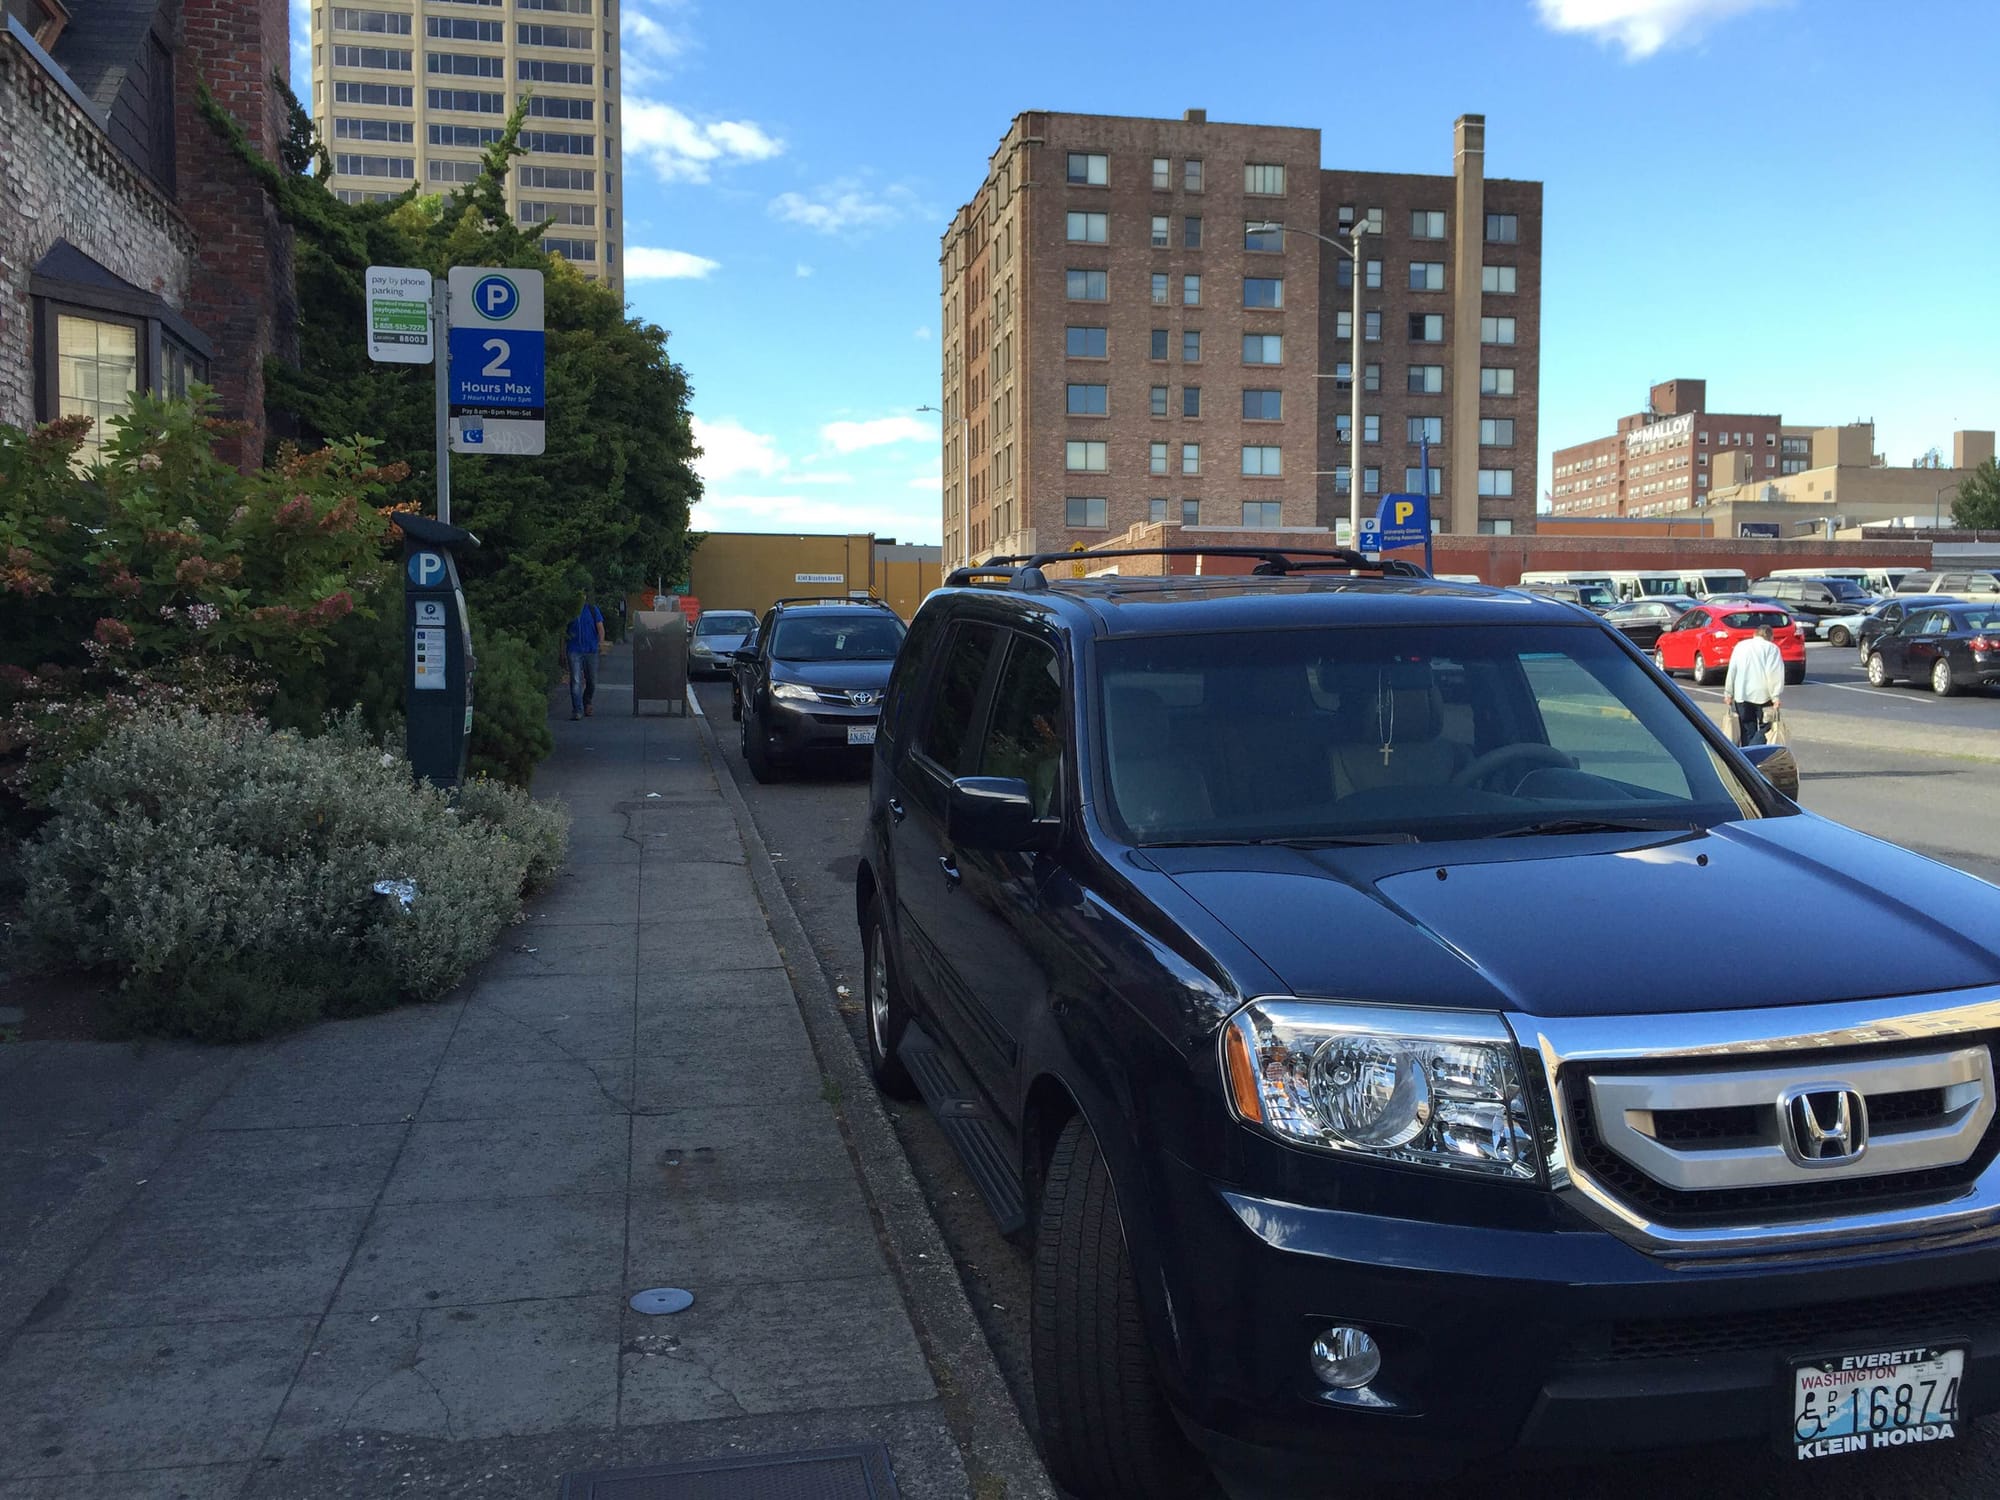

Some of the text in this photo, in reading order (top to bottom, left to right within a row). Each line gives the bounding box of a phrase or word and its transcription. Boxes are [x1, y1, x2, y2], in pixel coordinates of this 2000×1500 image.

[372, 277, 387, 285] pay
[400, 277, 425, 286] phone
[372, 287, 404, 296] parking
[487, 284, 509, 311] P
[373, 307, 426, 315] paybyphone.com
[482, 338, 511, 377] 2
[461, 381, 532, 394] Hours Max
[461, 408, 473, 416] Pay
[1642, 415, 1692, 442] MALLOY
[1395, 501, 1414, 525] P
[1366, 534, 1374, 545] 2
[420, 553, 442, 585] P
[1841, 1348, 1926, 1371] EVERETT
[1801, 1365, 1897, 1390] WASHINGTON
[1828, 1390, 1838, 1403] D
[1851, 1376, 1959, 1433] 16874
[1827, 1405, 1836, 1418] P
[1797, 1423, 1955, 1461] KLEIN HONDA
